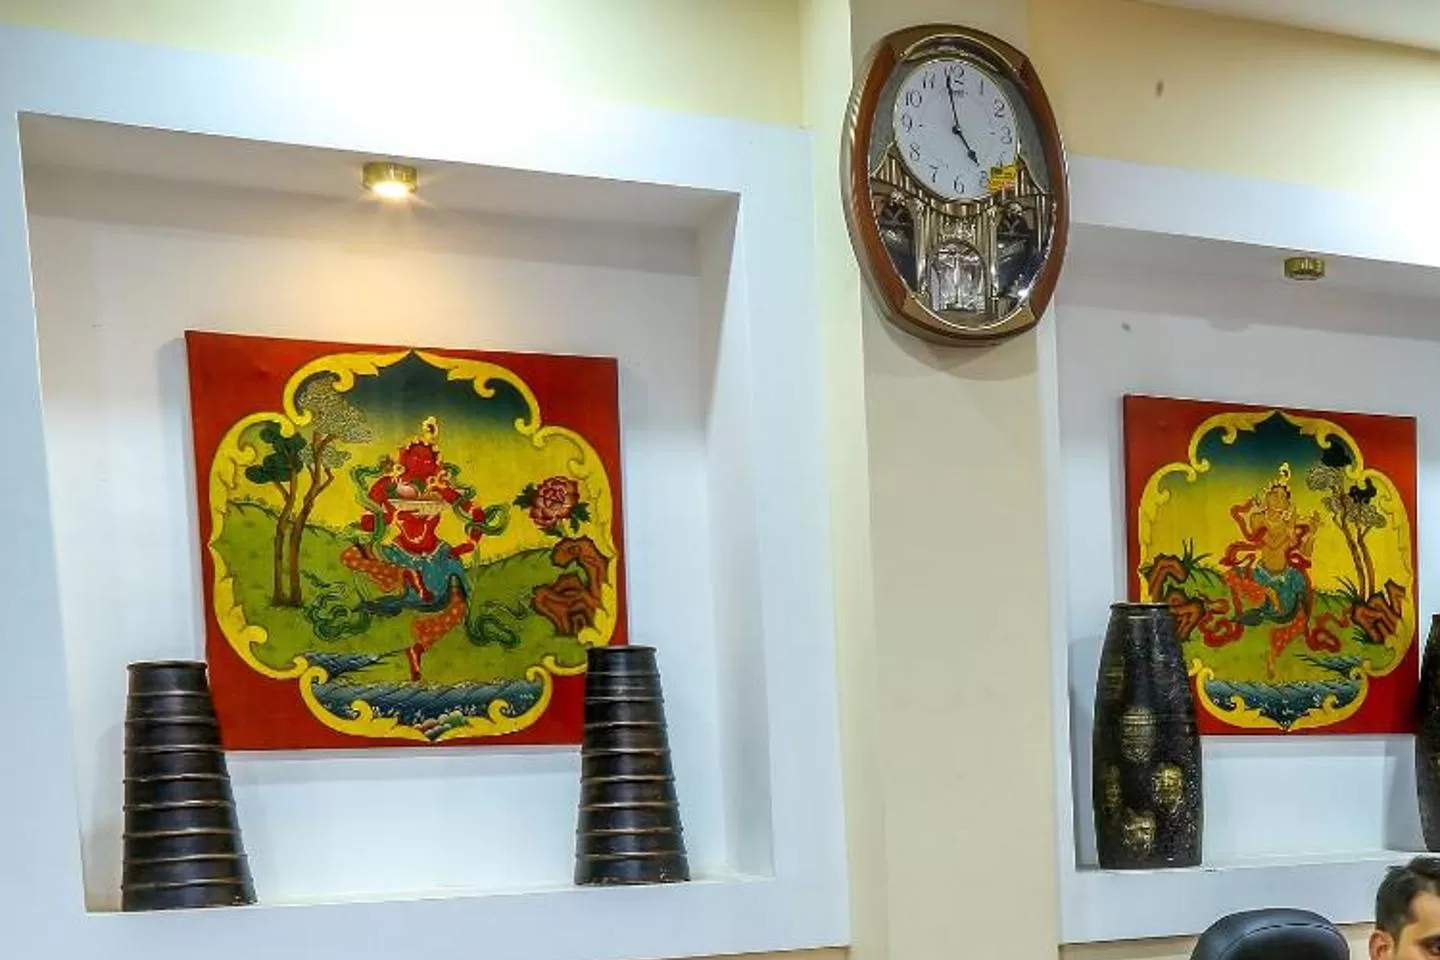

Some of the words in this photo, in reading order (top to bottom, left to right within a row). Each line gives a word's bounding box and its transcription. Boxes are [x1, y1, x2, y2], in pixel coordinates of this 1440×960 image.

[905, 90, 922, 108] 10
[993, 99, 1005, 118] 2
[901, 113, 913, 133] 9
[1000, 125, 1013, 145] 3
[909, 142, 921, 161] 8
[928, 164, 939, 183] 7
[953, 175, 965, 194] 6
